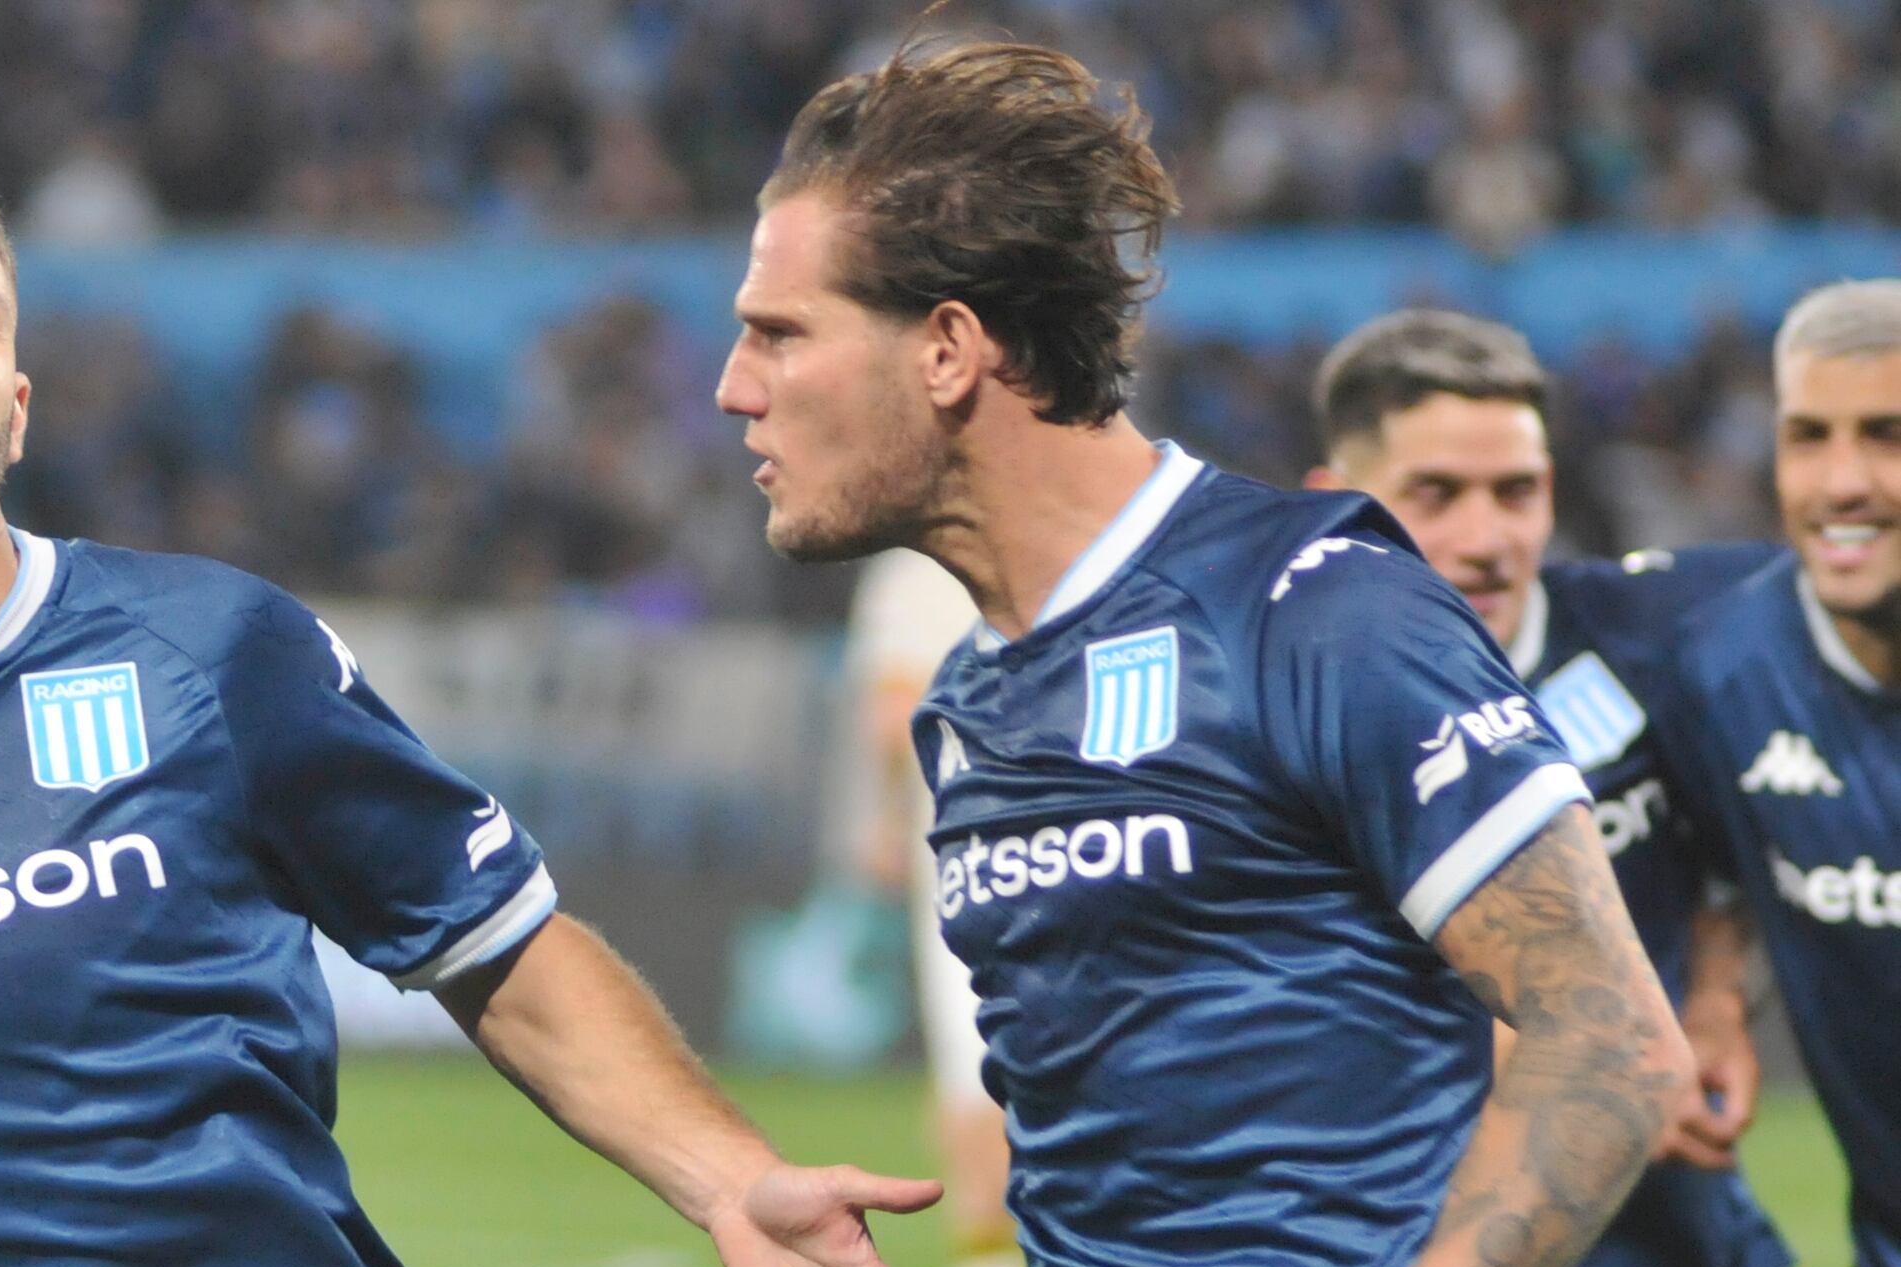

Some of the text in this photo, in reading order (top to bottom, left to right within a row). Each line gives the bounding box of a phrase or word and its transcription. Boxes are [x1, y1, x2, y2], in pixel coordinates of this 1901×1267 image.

[32, 673, 128, 702] RACING
[1456, 694, 1536, 748] RUS
[938, 813, 1193, 920] etsson
